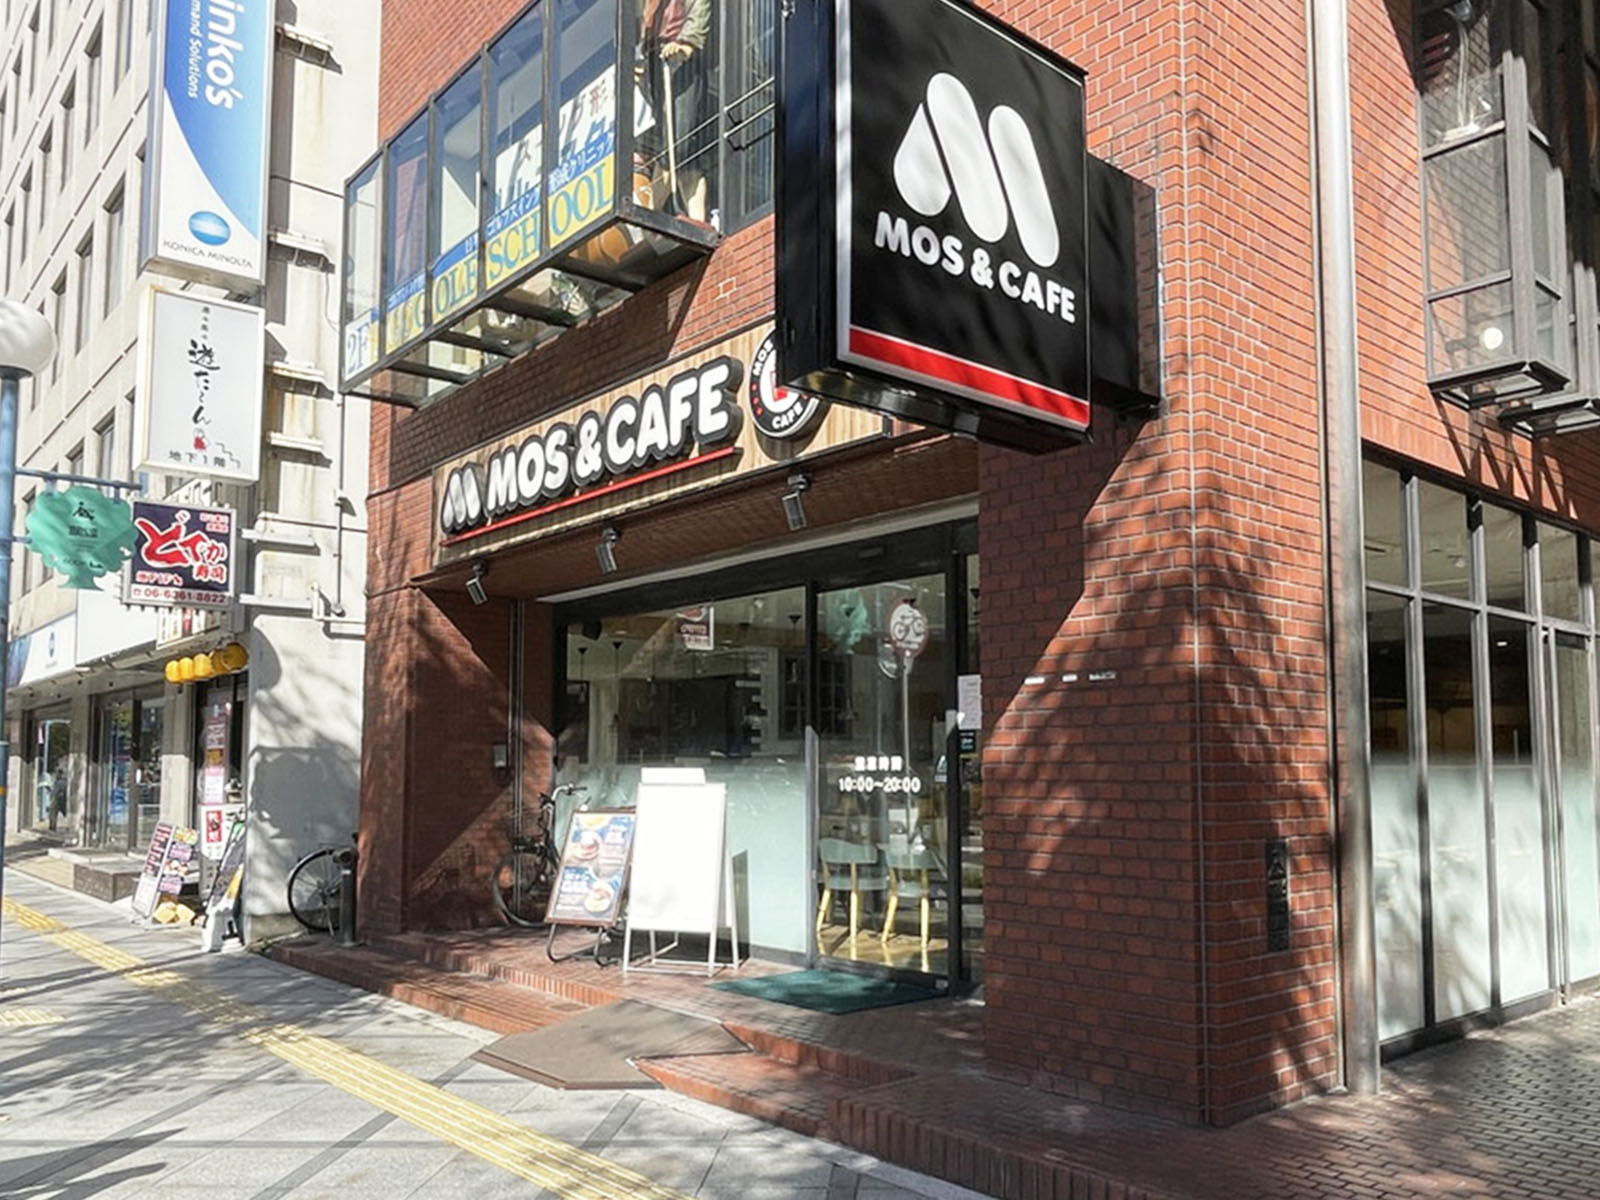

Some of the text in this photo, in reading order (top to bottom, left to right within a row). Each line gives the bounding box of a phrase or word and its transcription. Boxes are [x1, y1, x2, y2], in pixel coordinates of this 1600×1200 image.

[187, 38, 203, 99] Solutions
[163, 240, 254, 269] KONICA MINOLTA
[874, 211, 1076, 324] MOS & CAFE
[487, 428, 571, 512] MOS
[576, 416, 602, 477] &
[607, 364, 730, 464] CAFE
[772, 402, 803, 429] CAFE
